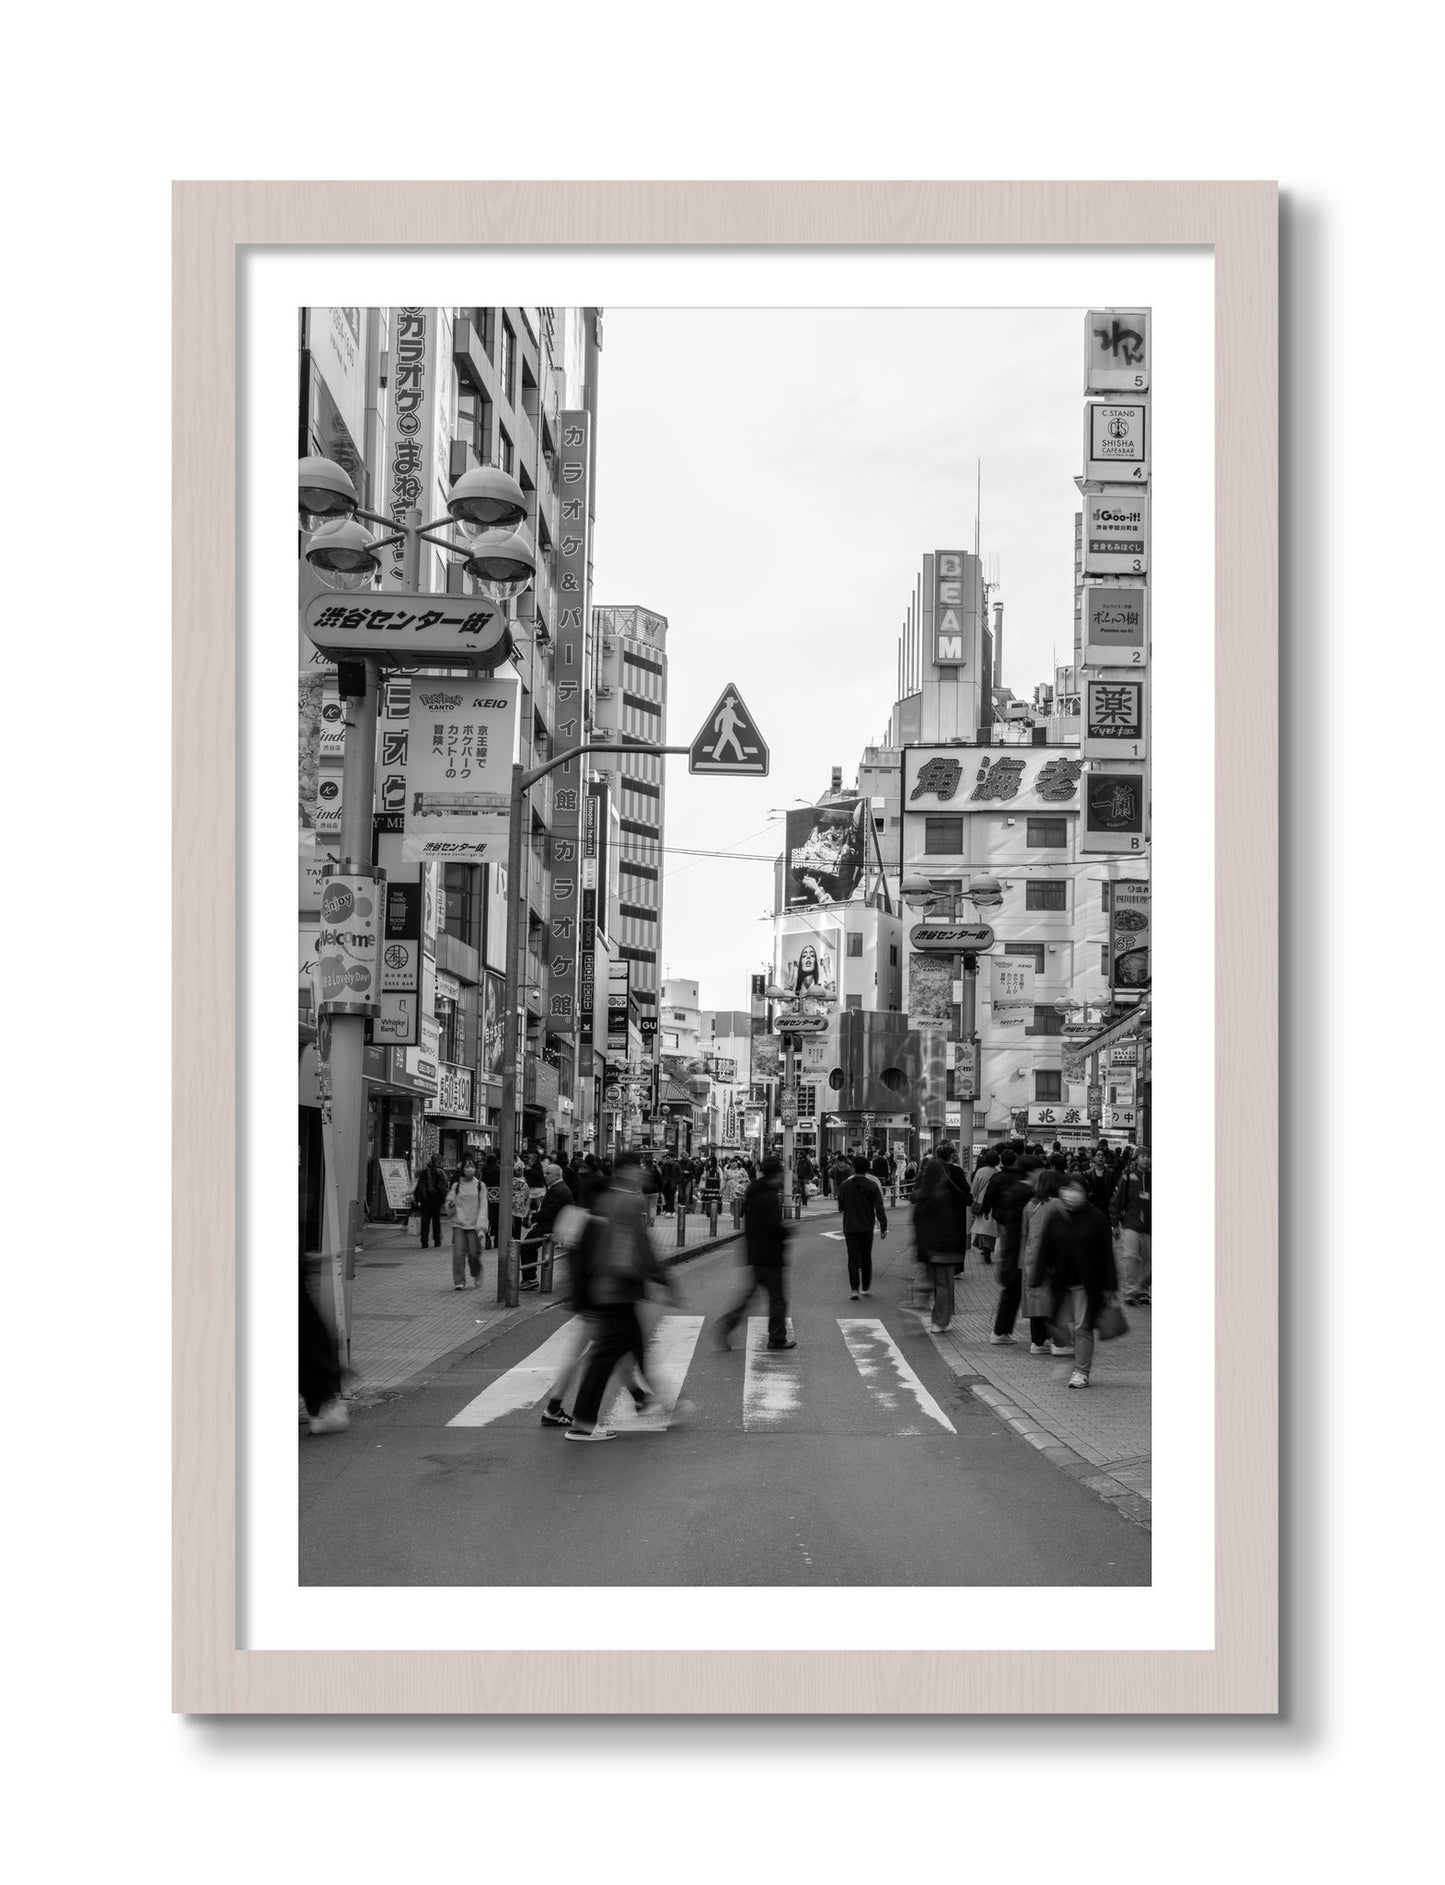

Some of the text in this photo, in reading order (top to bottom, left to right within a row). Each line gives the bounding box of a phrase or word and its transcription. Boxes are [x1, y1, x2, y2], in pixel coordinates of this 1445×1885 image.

[395, 314, 426, 413] カラオケ
[1135, 376, 1143, 386] 5
[1101, 510, 1140, 521] Goo-it!
[1092, 543, 1141, 551] 全身もみほぐし
[1133, 560, 1141, 571] 3
[938, 554, 962, 659] BEAM
[314, 606, 494, 634] 渋谷センター街
[1132, 652, 1141, 663] 2
[472, 699, 508, 709] KEIO
[1096, 687, 1132, 724] 薬
[432, 725, 444, 755] 冒険へ
[445, 725, 459, 779] カントーの
[460, 725, 474, 779] ポケパーク
[476, 725, 488, 769] 京王線で
[1132, 744, 1138, 756] 1
[910, 757, 1082, 801] 角海老
[422, 842, 488, 852] 渋谷センター街
[1131, 838, 1139, 849] B
[323, 892, 352, 917] Enjoy
[915, 930, 990, 940] 渋谷センター街
[1114, 937, 1136, 951] 6F
[381, 1019, 405, 1027] Whisky
[642, 1022, 657, 1030] GU
[1038, 1108, 1081, 1123] 兆楽
